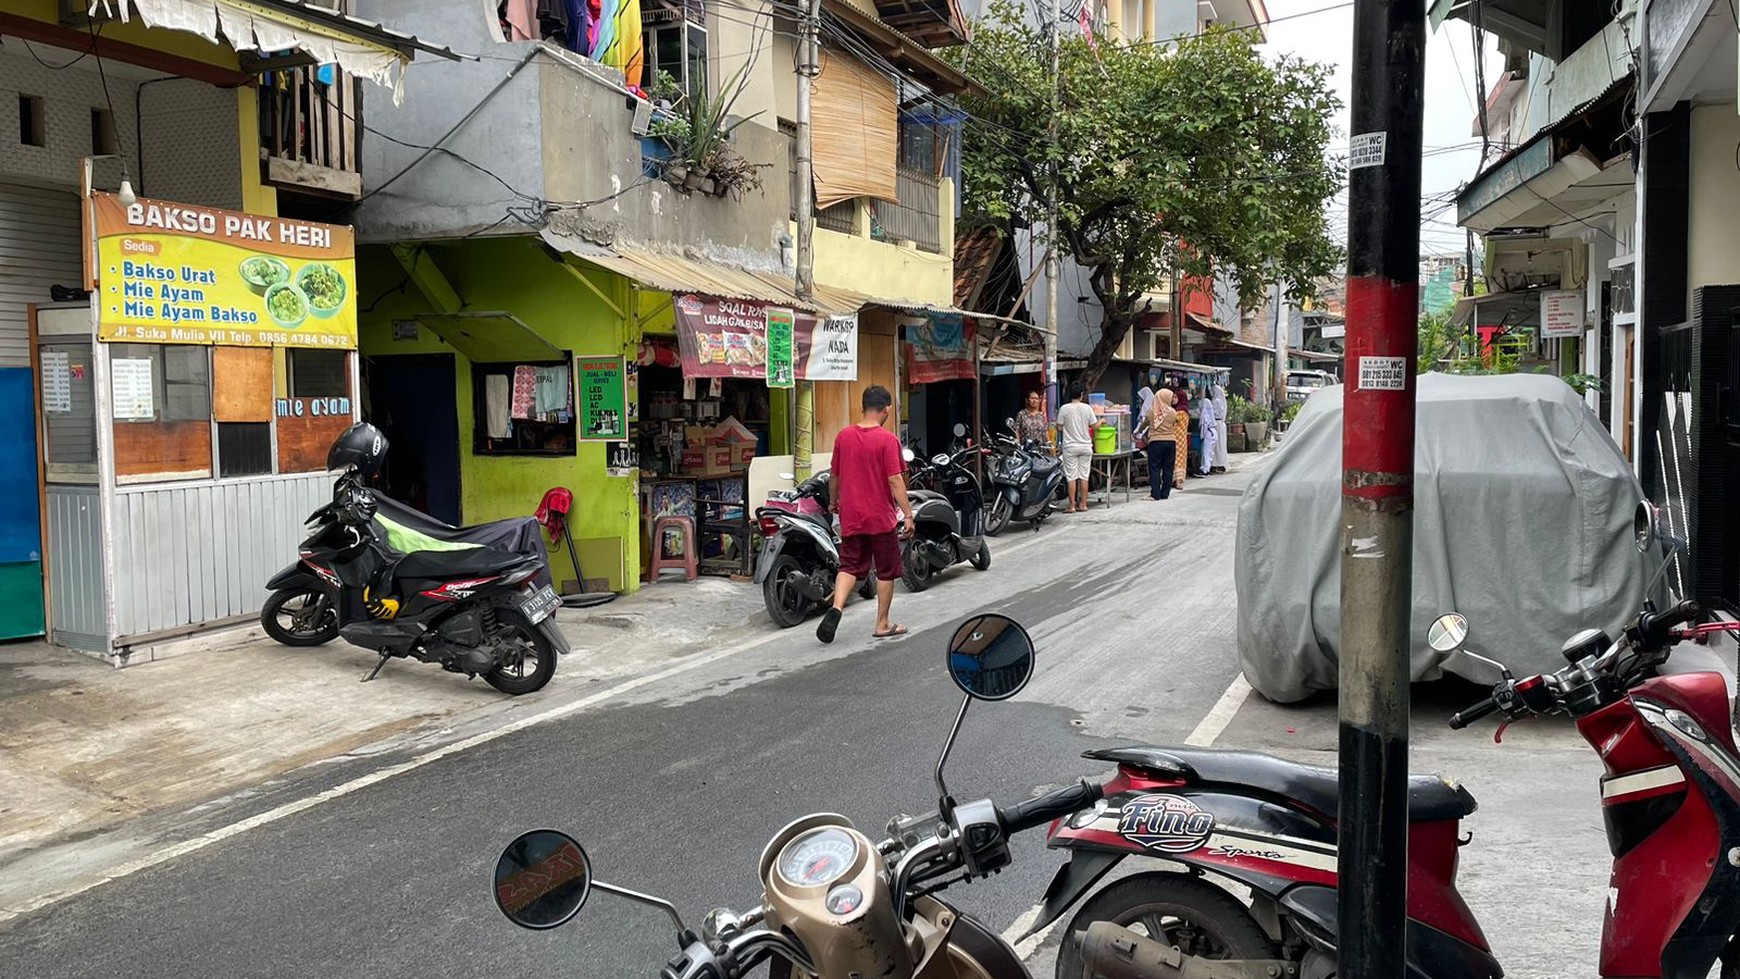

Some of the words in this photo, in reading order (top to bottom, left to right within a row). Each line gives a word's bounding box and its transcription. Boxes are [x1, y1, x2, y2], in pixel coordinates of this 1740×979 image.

[1368, 135, 1382, 145] WC
[127, 203, 216, 235] BAKSO
[225, 216, 272, 241] PAK
[280, 223, 331, 248] HERI
[123, 239, 155, 253] Sedia
[123, 261, 176, 280] Bakso
[181, 267, 216, 283] Urat
[124, 281, 154, 298] Mie
[161, 284, 204, 303] Ayam
[124, 301, 155, 317] Mie
[161, 303, 205, 322] Ayam
[211, 307, 258, 323] Bakso
[718, 301, 747, 316] SOAL
[704, 314, 728, 326] LIDAH
[745, 318, 765, 330] BISA
[823, 319, 854, 333] WARKOP
[136, 327, 167, 339] Suka
[171, 327, 205, 340] Mulia
[209, 330, 225, 341] VII
[229, 331, 255, 343] Telp.
[259, 332, 288, 343] 0856
[828, 340, 849, 354] NADA
[1390, 360, 1403, 369] WC
[277, 399, 303, 416] mie
[311, 397, 349, 416] ayam
[1120, 799, 1214, 835] Fino
